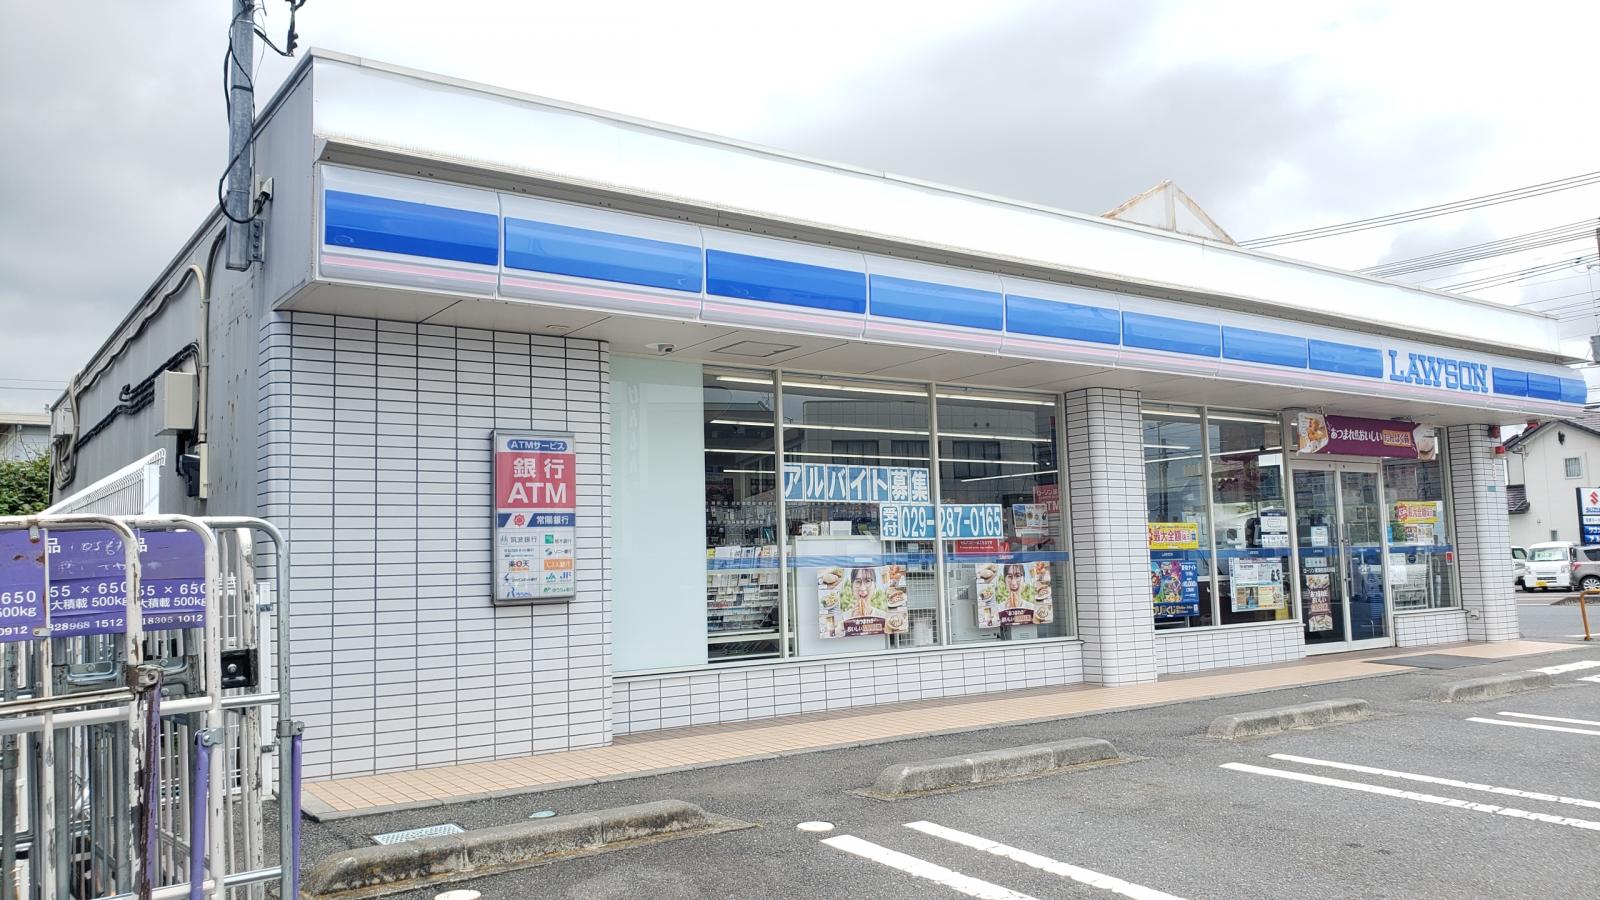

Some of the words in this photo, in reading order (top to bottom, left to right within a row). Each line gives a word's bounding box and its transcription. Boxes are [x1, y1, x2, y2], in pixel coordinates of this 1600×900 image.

[1388, 349, 1489, 393] LAWSON
[510, 440, 565, 451] ATMサービス
[513, 457, 565, 479] 銀行
[784, 465, 929, 501] アルバイト募集
[507, 482, 567, 504] ATM
[882, 506, 899, 536] 受付
[901, 506, 1002, 538] 029-287-0165
[48, 537, 61, 554] 品
[1, 590, 37, 605] 650
[95, 618, 124, 628] 1512
[178, 614, 204, 623] 1012
